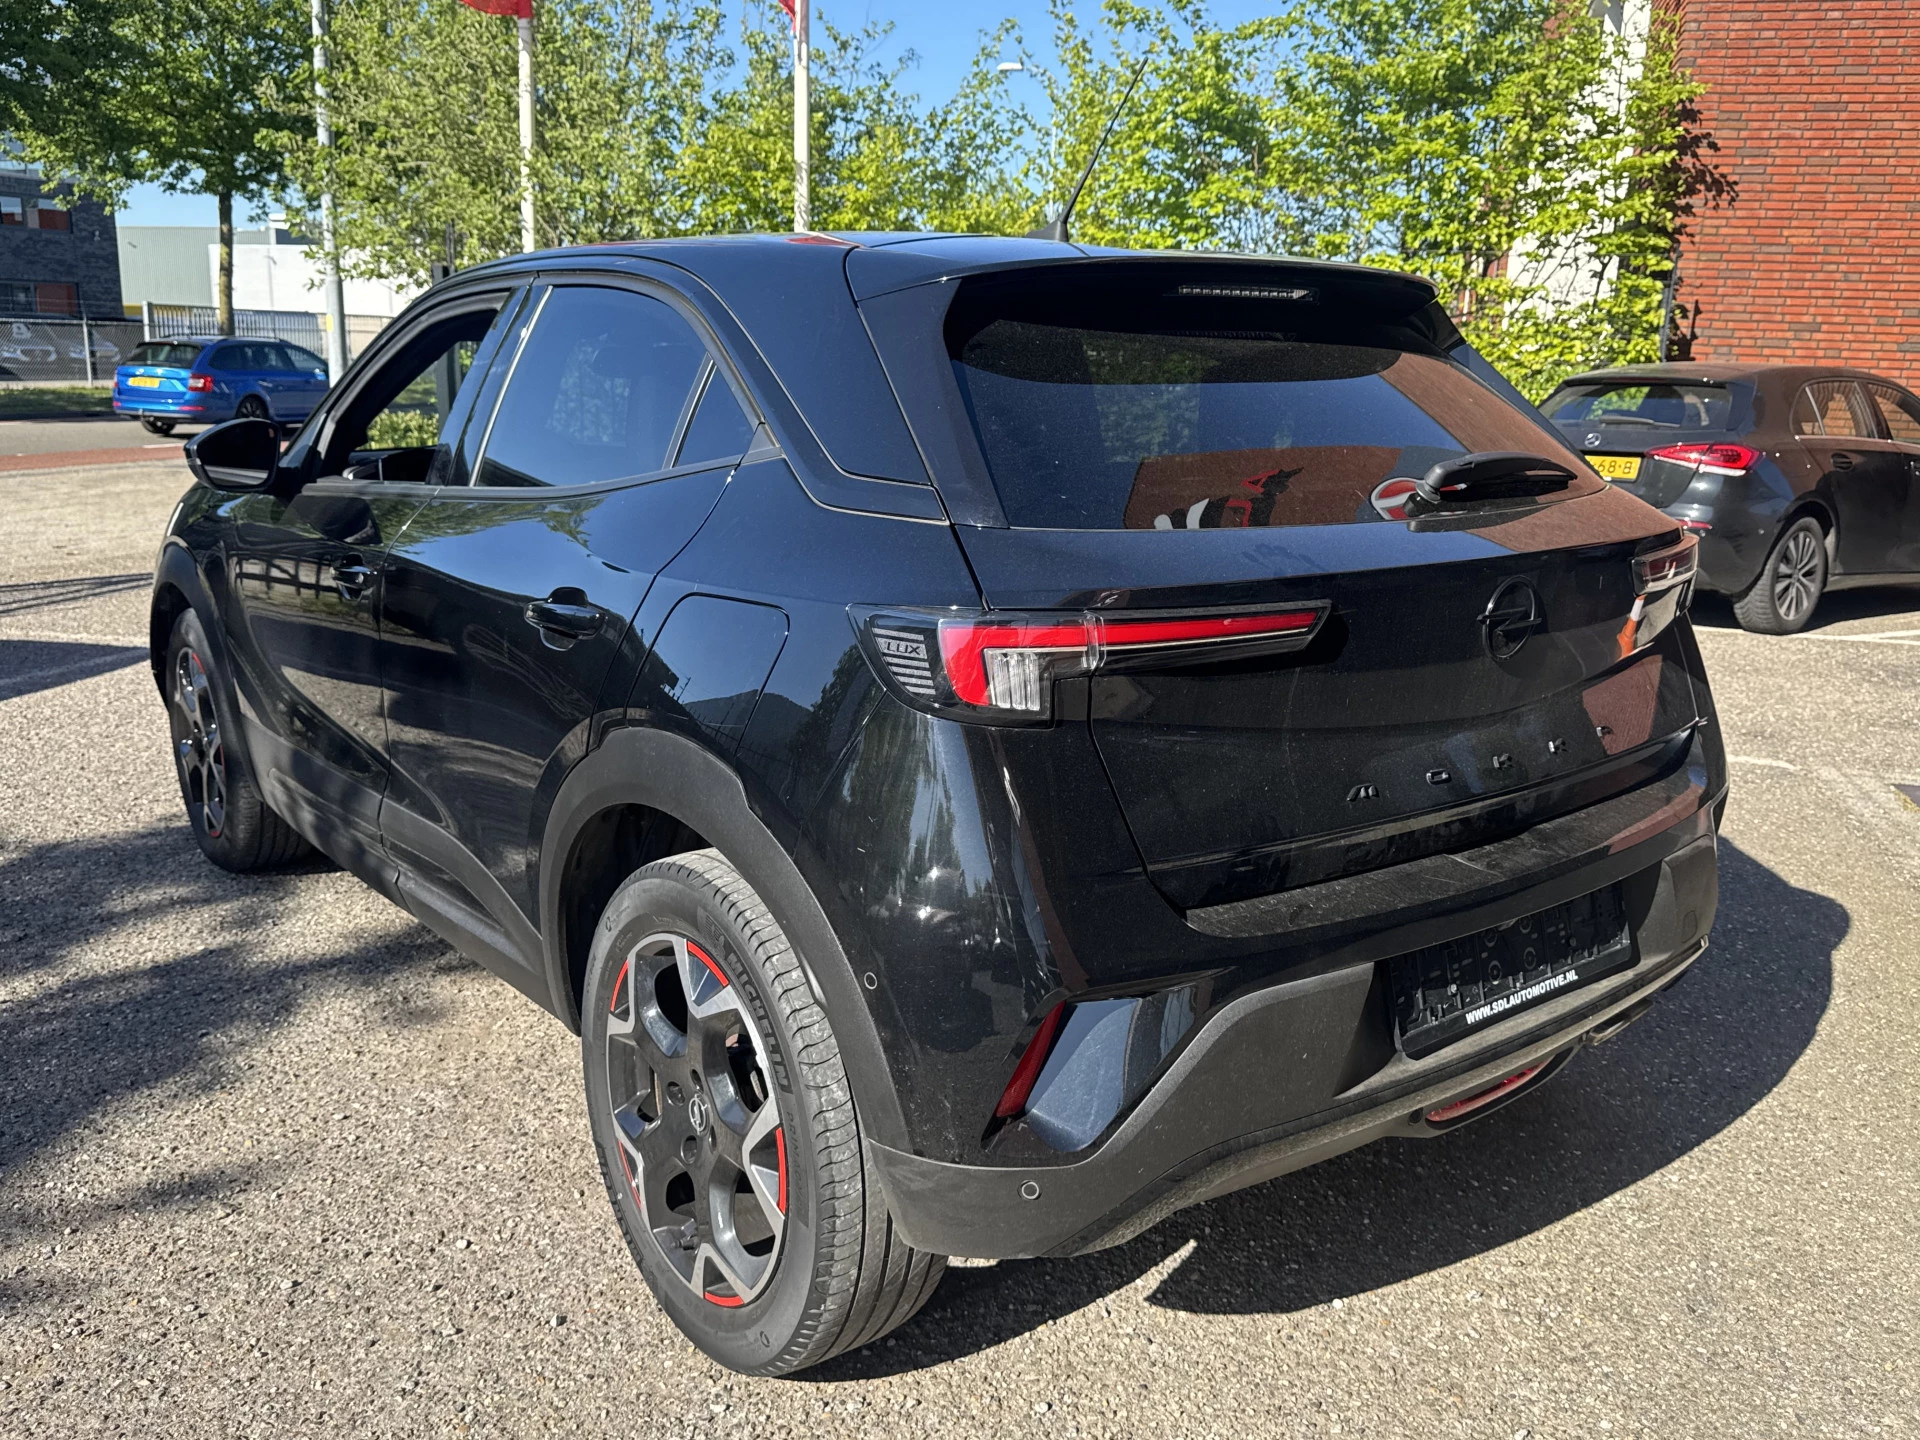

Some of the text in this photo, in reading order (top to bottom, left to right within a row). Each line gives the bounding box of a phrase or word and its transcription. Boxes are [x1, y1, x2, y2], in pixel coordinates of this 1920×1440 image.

[886, 641, 921, 656] LUX
[726, 951, 788, 1087] MICHELIN
[1465, 969, 1579, 1025] WWW.SDLAUTOMOTIVE.NL
